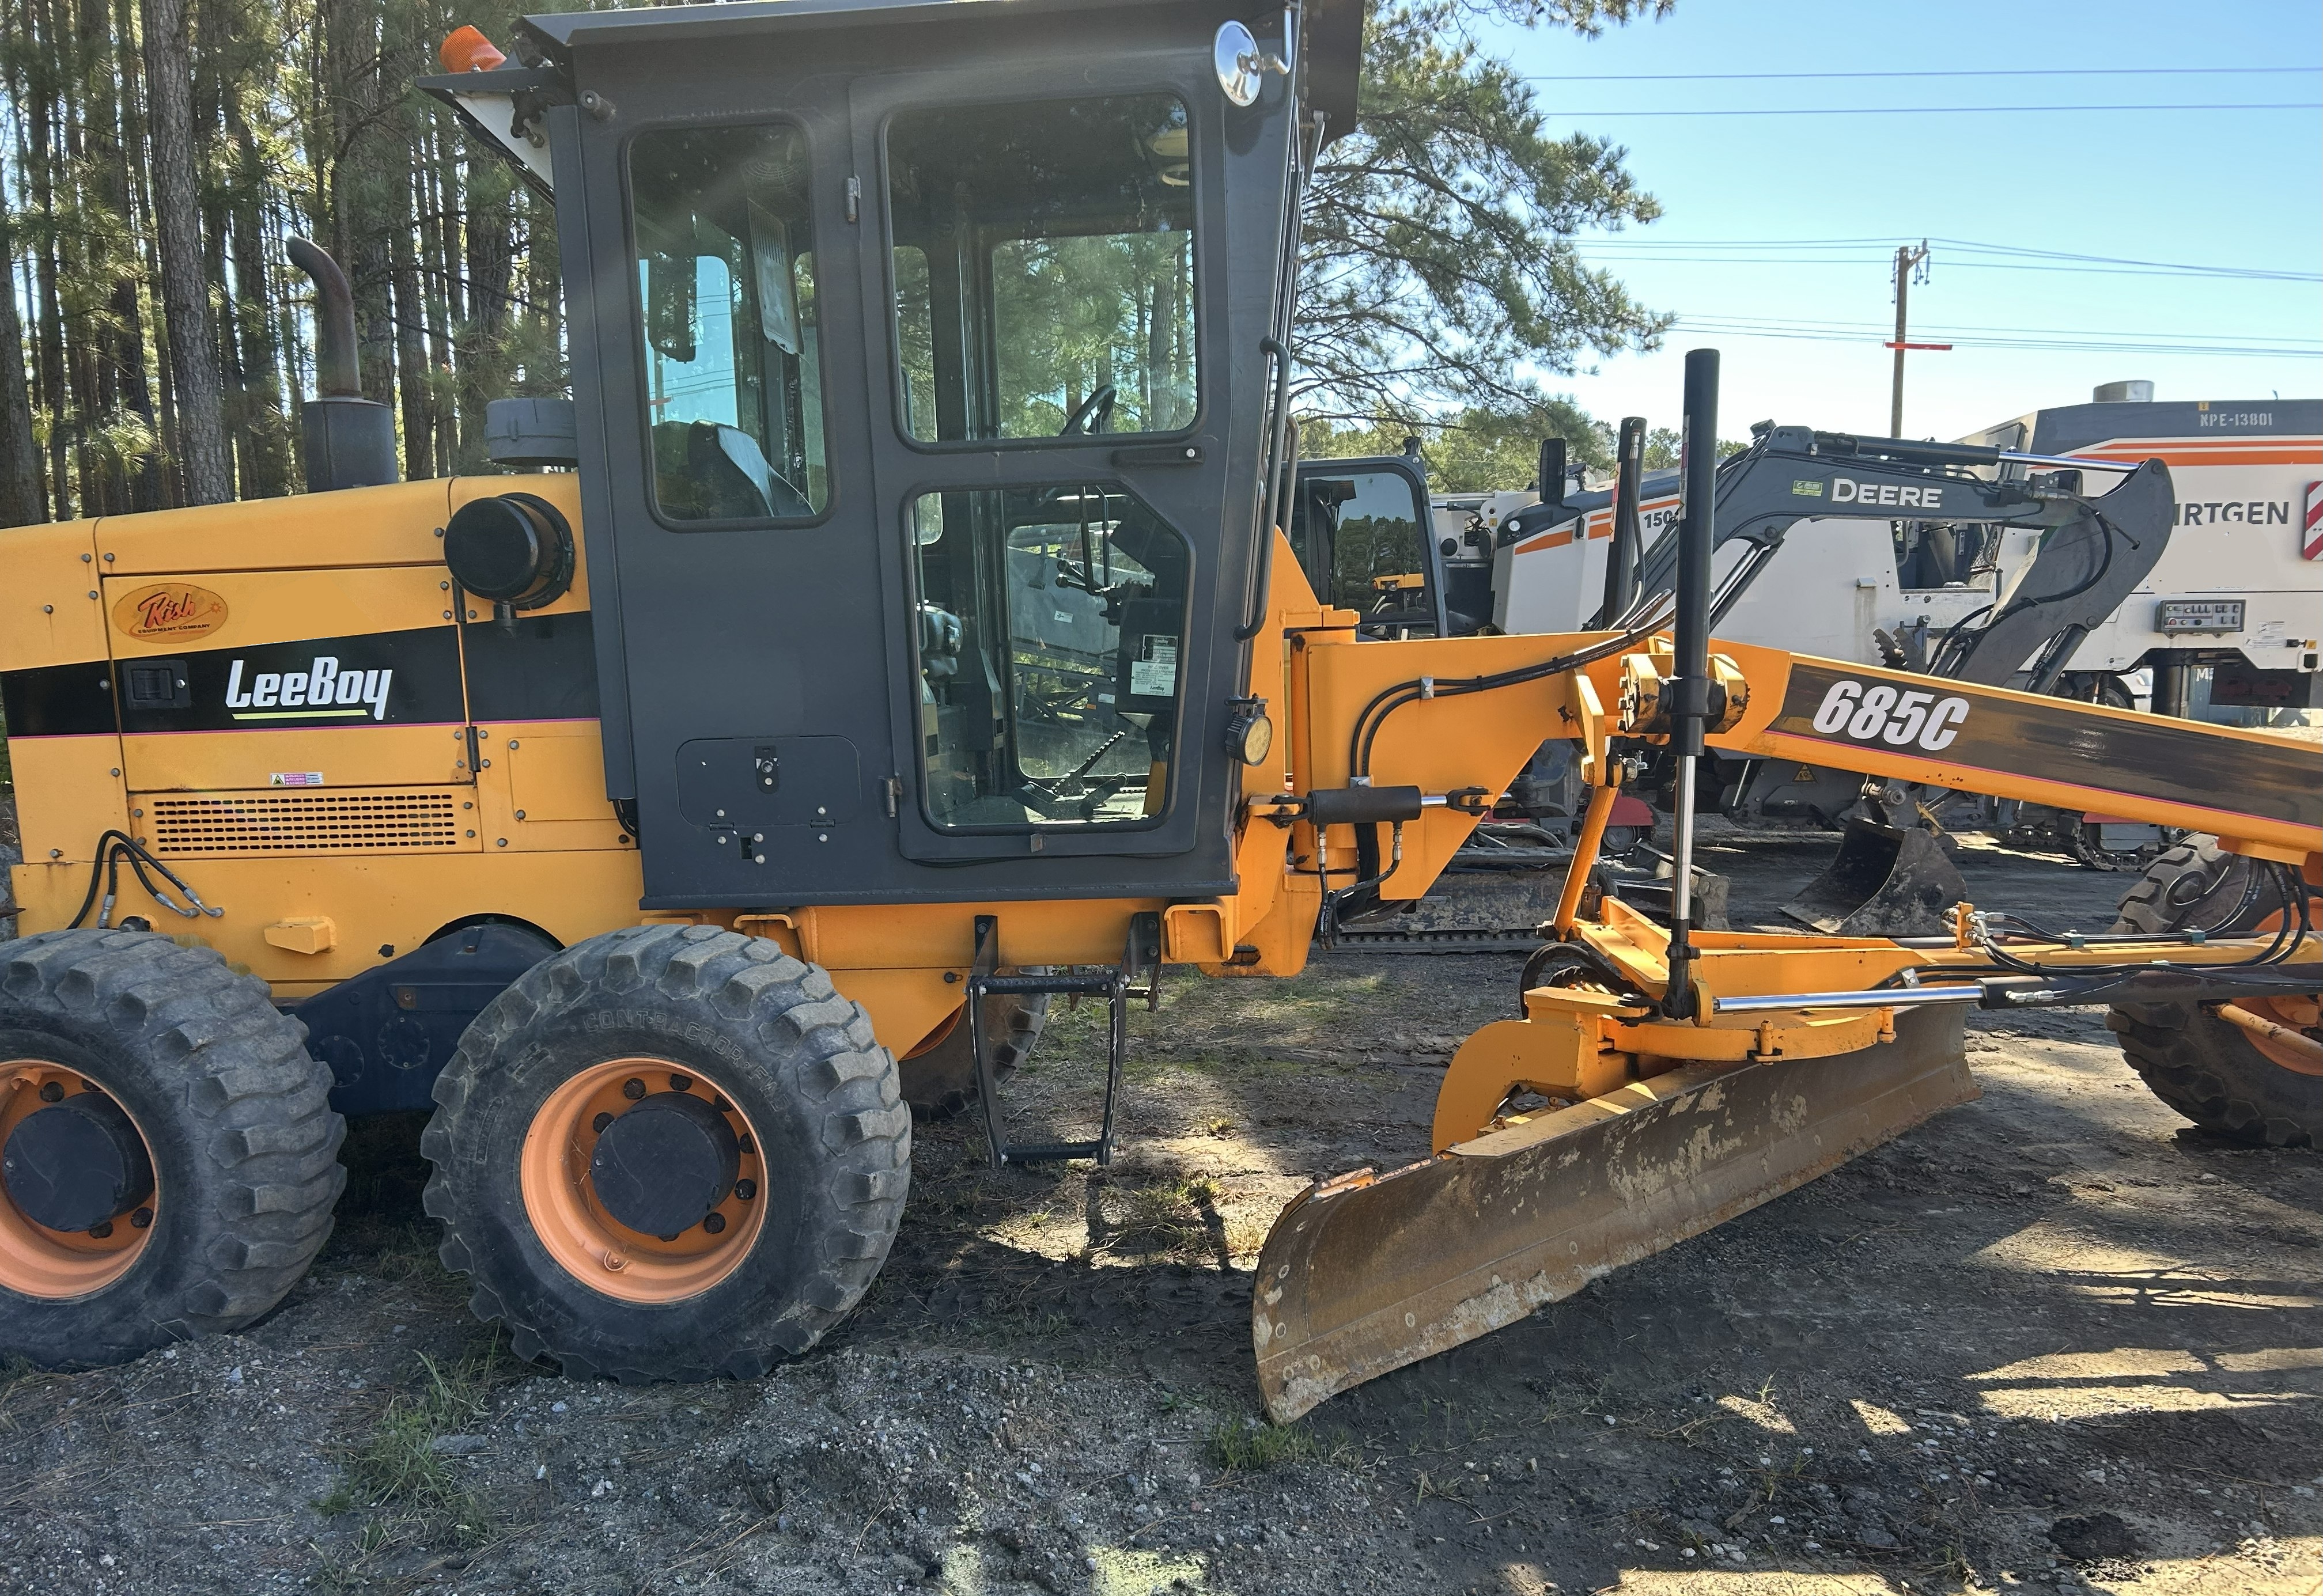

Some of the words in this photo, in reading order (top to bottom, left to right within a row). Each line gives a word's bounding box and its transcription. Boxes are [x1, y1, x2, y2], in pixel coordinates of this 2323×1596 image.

[2200, 413, 2272, 427] NPE-13801
[1832, 478, 1942, 508] DEERE
[2172, 502, 2290, 526] IRTGEN
[138, 592, 196, 628] Rish
[138, 626, 176, 634] EQUIPMENT
[225, 657, 393, 721] LeeBoy
[1813, 680, 1969, 751] 685C
[582, 1010, 744, 1067] CONTRACTOR
